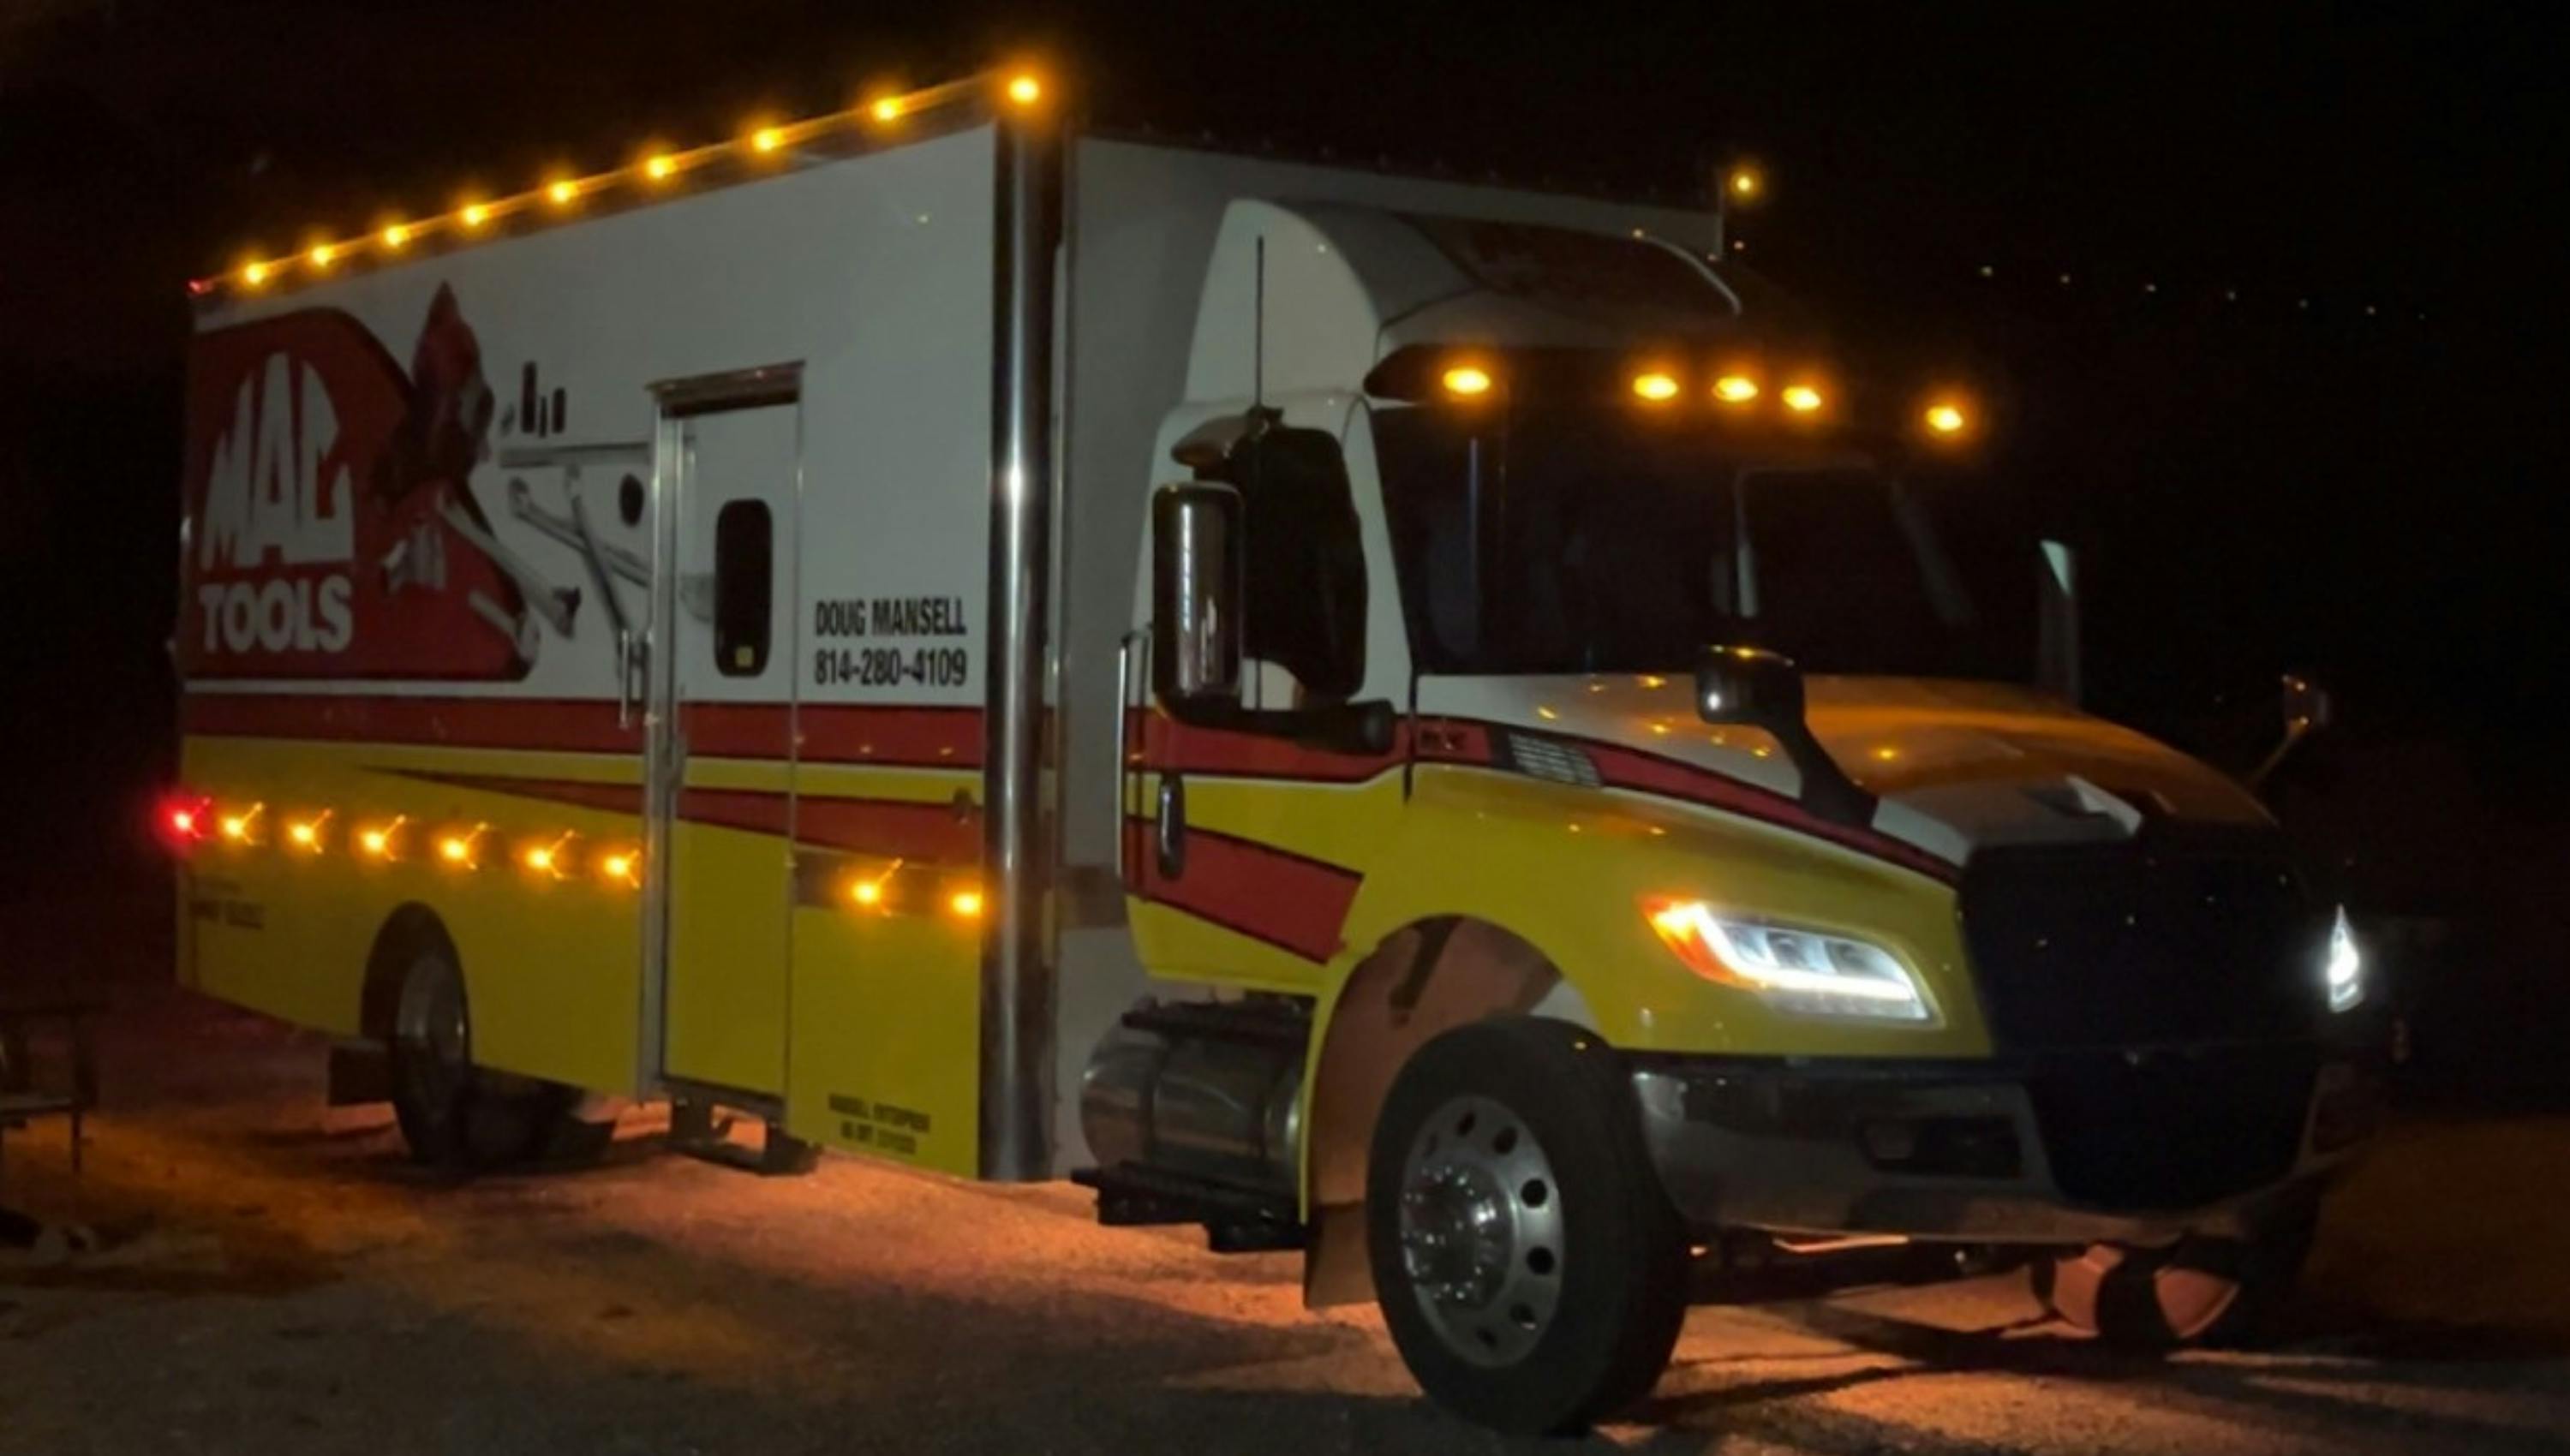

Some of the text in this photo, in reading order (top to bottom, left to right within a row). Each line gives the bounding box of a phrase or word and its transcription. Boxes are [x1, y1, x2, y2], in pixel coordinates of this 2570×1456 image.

[200, 351, 355, 570] MAC
[198, 574, 354, 653] TOOLS
[816, 597, 966, 636] DOUG MANSELL
[816, 647, 966, 685] 814-280-4109
